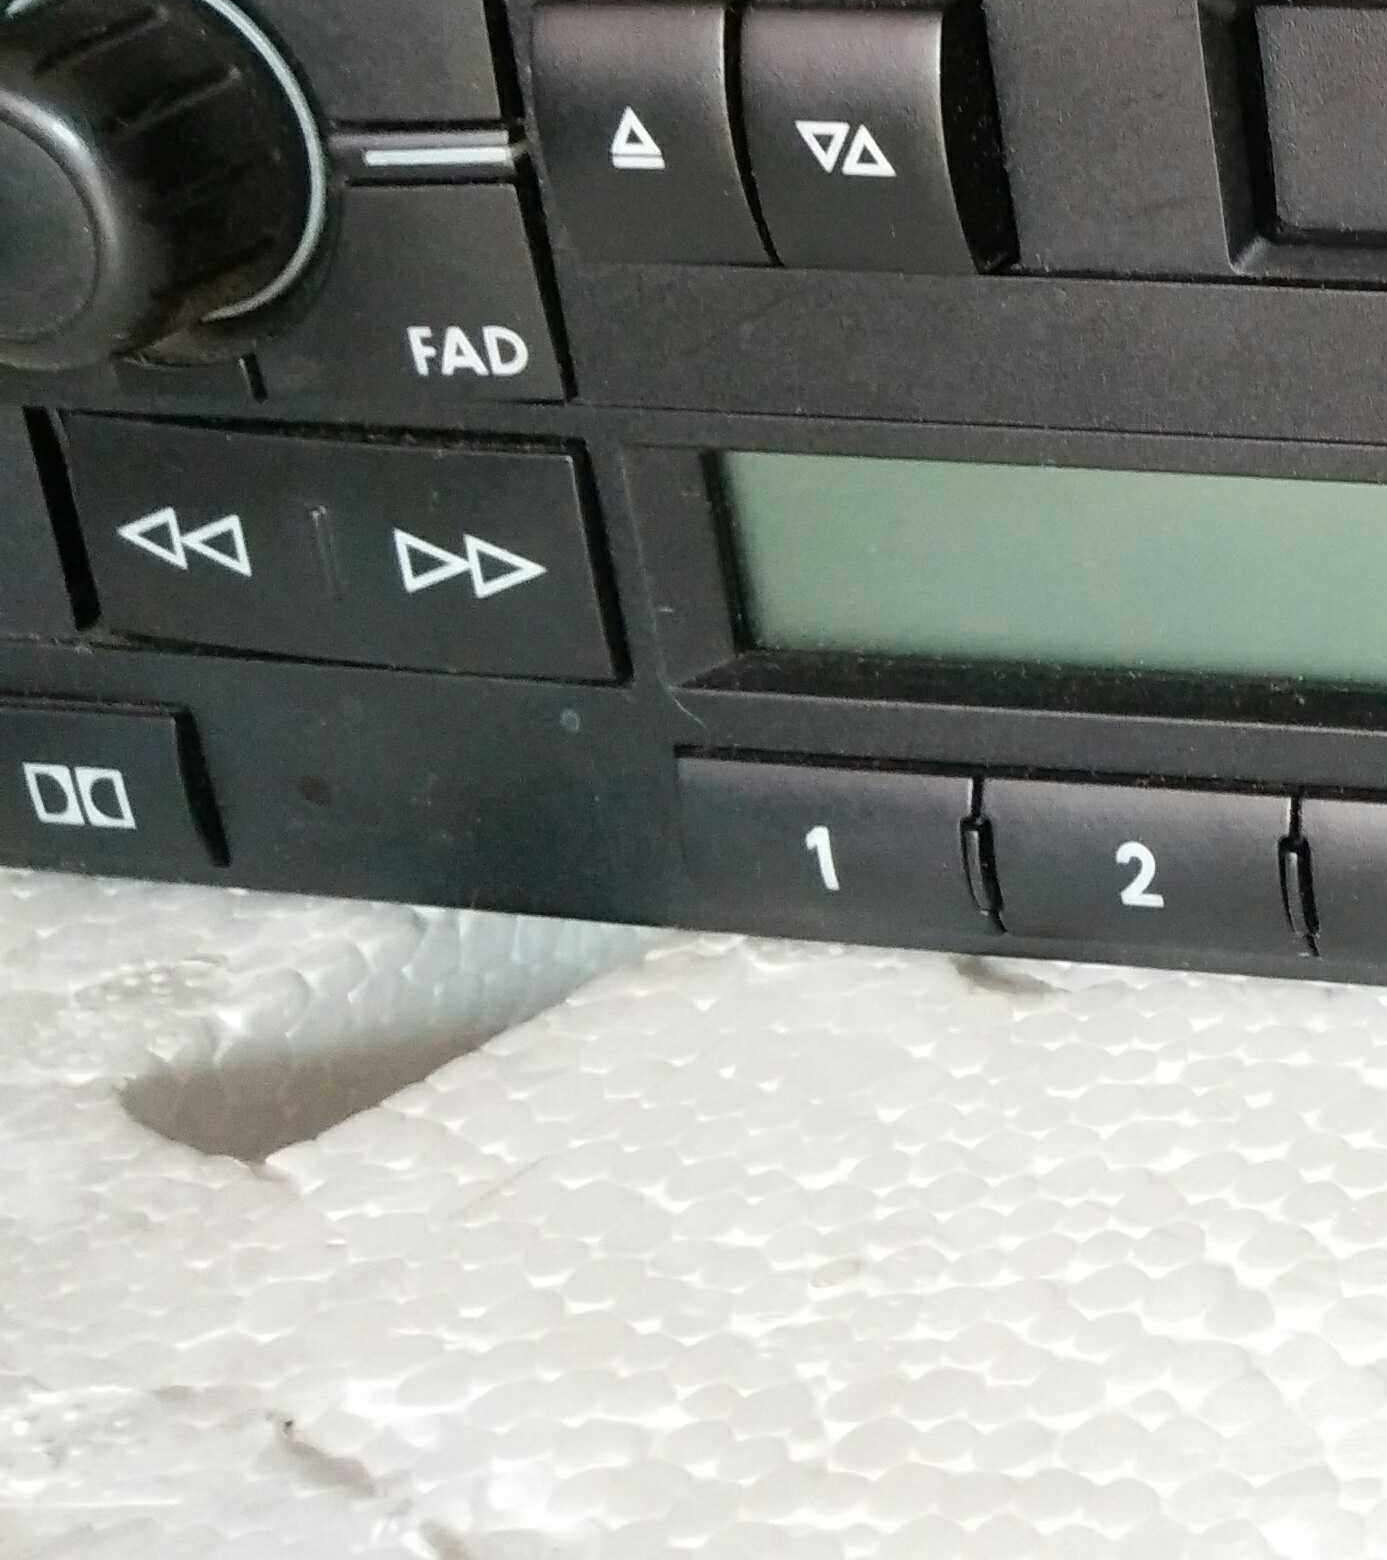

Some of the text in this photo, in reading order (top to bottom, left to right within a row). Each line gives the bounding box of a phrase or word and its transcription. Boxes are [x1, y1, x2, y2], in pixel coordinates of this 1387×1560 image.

[407, 325, 529, 376] FAD
[805, 825, 840, 891] 1
[1115, 840, 1165, 908] 2
